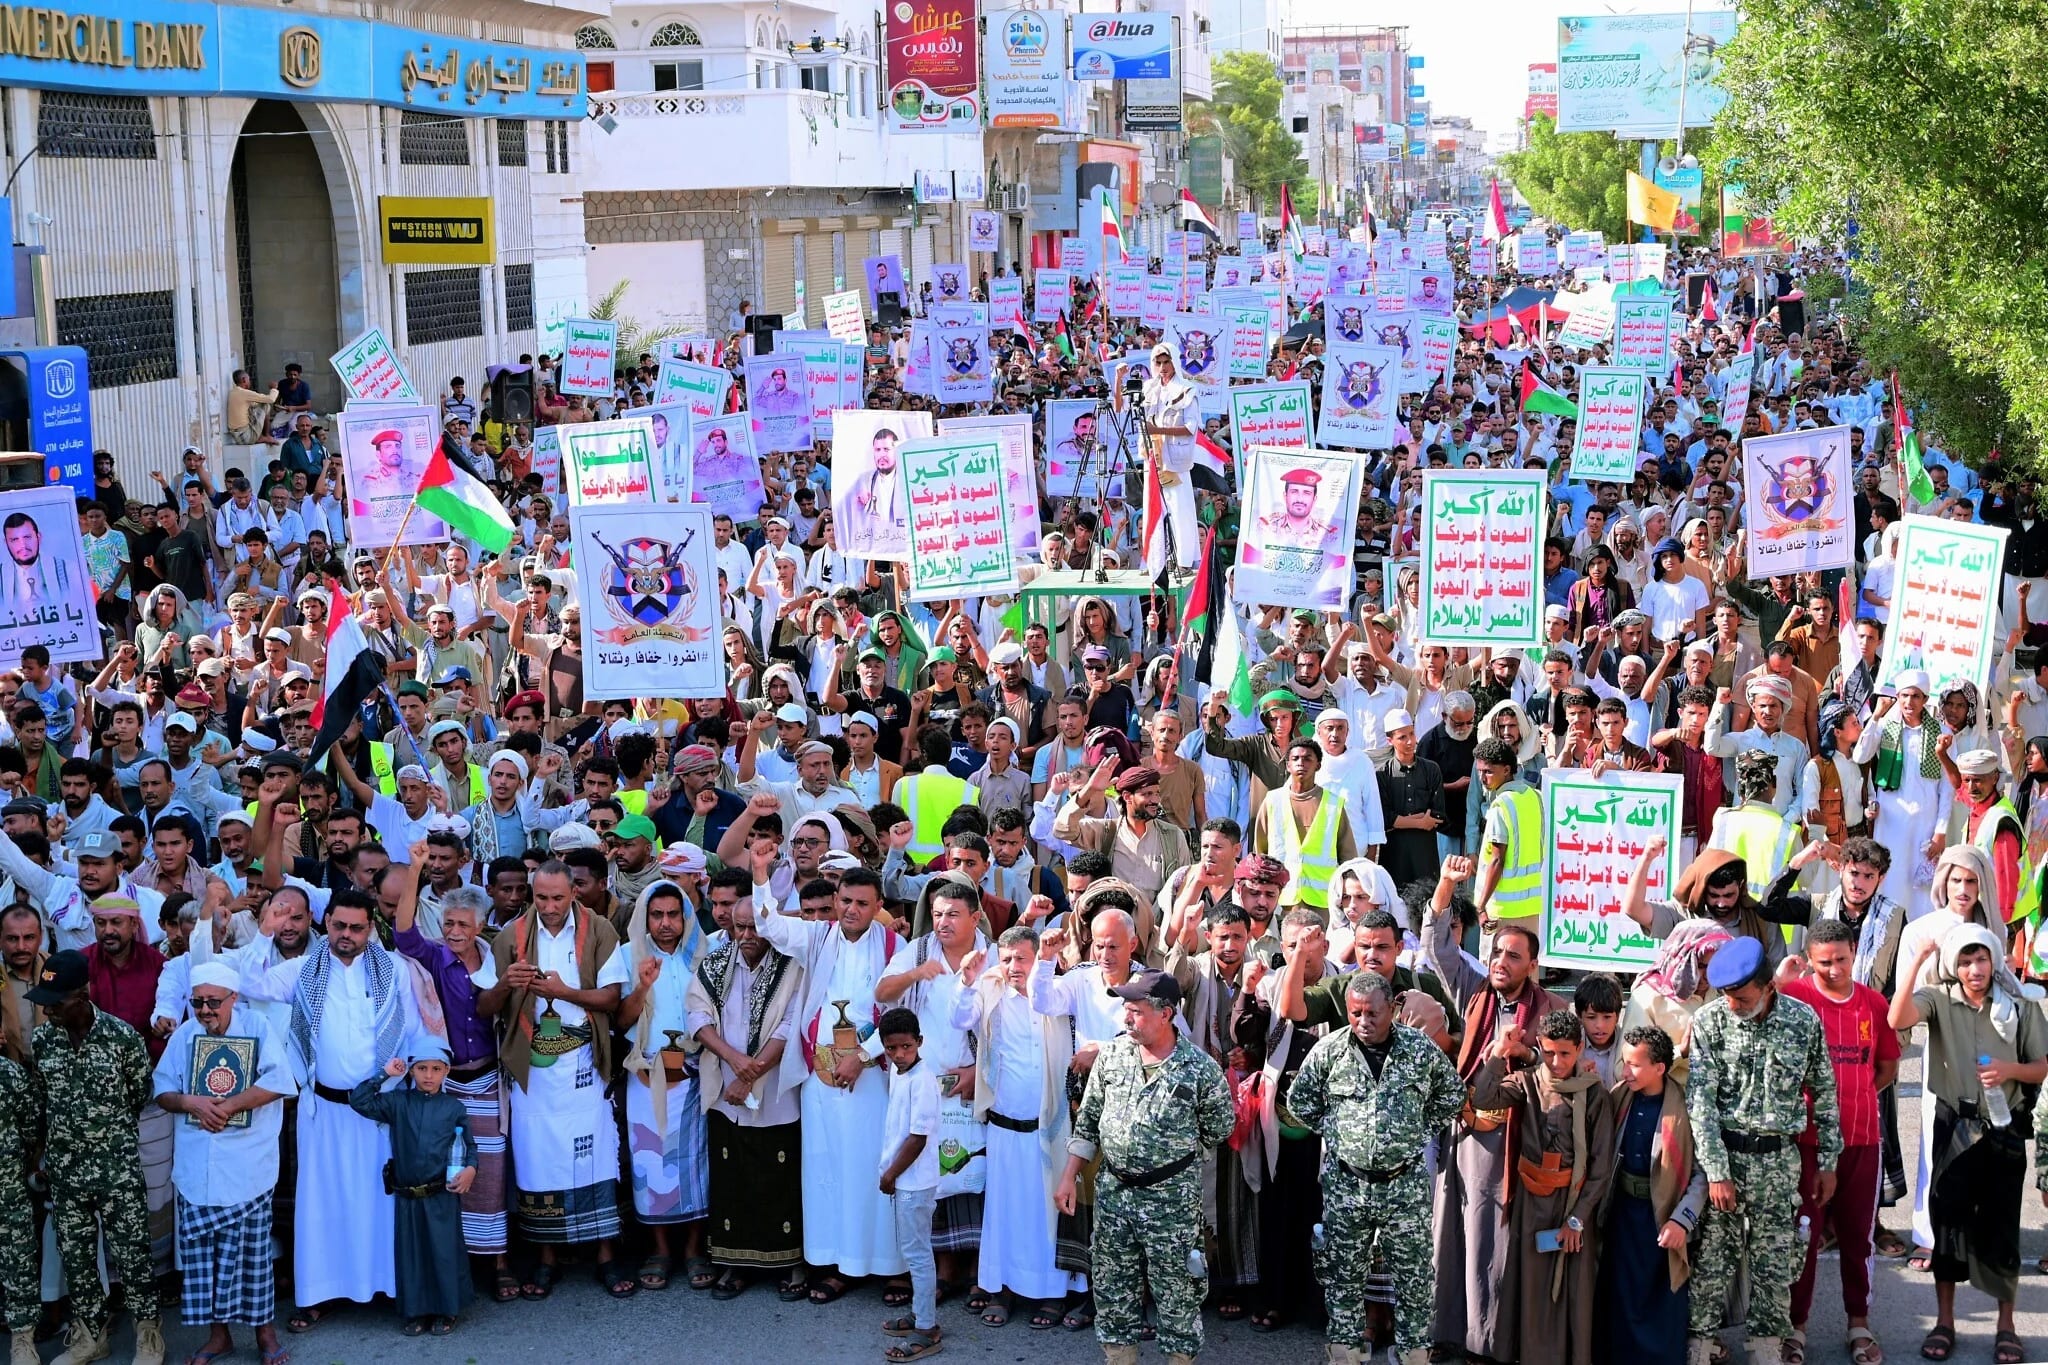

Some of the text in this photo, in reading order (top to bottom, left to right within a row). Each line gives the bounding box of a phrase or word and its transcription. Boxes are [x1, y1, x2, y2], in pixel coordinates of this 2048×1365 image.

[914, 3, 962, 35] عرش
[134, 21, 207, 69] BANK
[287, 36, 318, 79] YCB
[902, 36, 962, 57] بلقيس
[402, 43, 581, 107] البنك التجاري اليمني
[996, 96, 1023, 104] المحدودة
[1004, 85, 1025, 94] الأدوية
[391, 222, 443, 231] WESTERN
[407, 230, 443, 238] UNION
[447, 223, 478, 239] WU
[1623, 305, 1667, 319] الله أكبر
[571, 327, 610, 342] قاطعوا
[346, 347, 366, 377] أكبر
[48, 365, 73, 393] YCB
[667, 369, 717, 395] قاطعوا
[1587, 378, 1638, 398] الله أكبر
[1240, 393, 1304, 419] الله أكبر
[1586, 400, 1636, 416] الموت لأمريكا
[1240, 416, 1304, 434] الموت لأمريكا
[1584, 418, 1635, 433] الموت لإسرائيل
[46, 443, 57, 453] ATM
[1581, 437, 1633, 450] اللعنة على اليهود
[575, 441, 645, 472] قاطعوا
[909, 450, 996, 485] الله أكبر
[1577, 453, 1631, 472] النصر للإسلام
[64, 463, 82, 478] VISA
[581, 475, 616, 500] الأمريكية
[616, 474, 648, 498] البضائع
[911, 481, 999, 506] الموت لأمريكا
[962, 505, 1001, 526] الموت
[1435, 486, 1534, 522] الله أكبر
[914, 508, 961, 532] لإسرائيل
[916, 529, 1003, 555] اللعنة على اليهود
[1435, 521, 1532, 546] الموت لأمريكا
[918, 551, 1006, 584] النصر للإسلام
[1434, 551, 1532, 575] الموت لإسرائيل
[1910, 543, 1993, 573] الله أكبر
[1433, 578, 1531, 601] اللعنة على اليهود
[1906, 572, 1987, 603] الموت لأمريكا
[0, 602, 84, 631] يا قائدن
[1432, 603, 1530, 634] النصر للإسلام
[1902, 601, 1983, 631] الموت لإسرائيل
[622, 628, 685, 643] التعبئة العامة
[1899, 631, 1980, 657] اللعنة على اليهود
[1557, 792, 1667, 831] الله أكبر
[1556, 831, 1613, 857] لأمريكا
[1555, 863, 1613, 889] لإسرائيل
[1553, 893, 1621, 917] على اليهود
[1553, 919, 1609, 953] للإسلام
